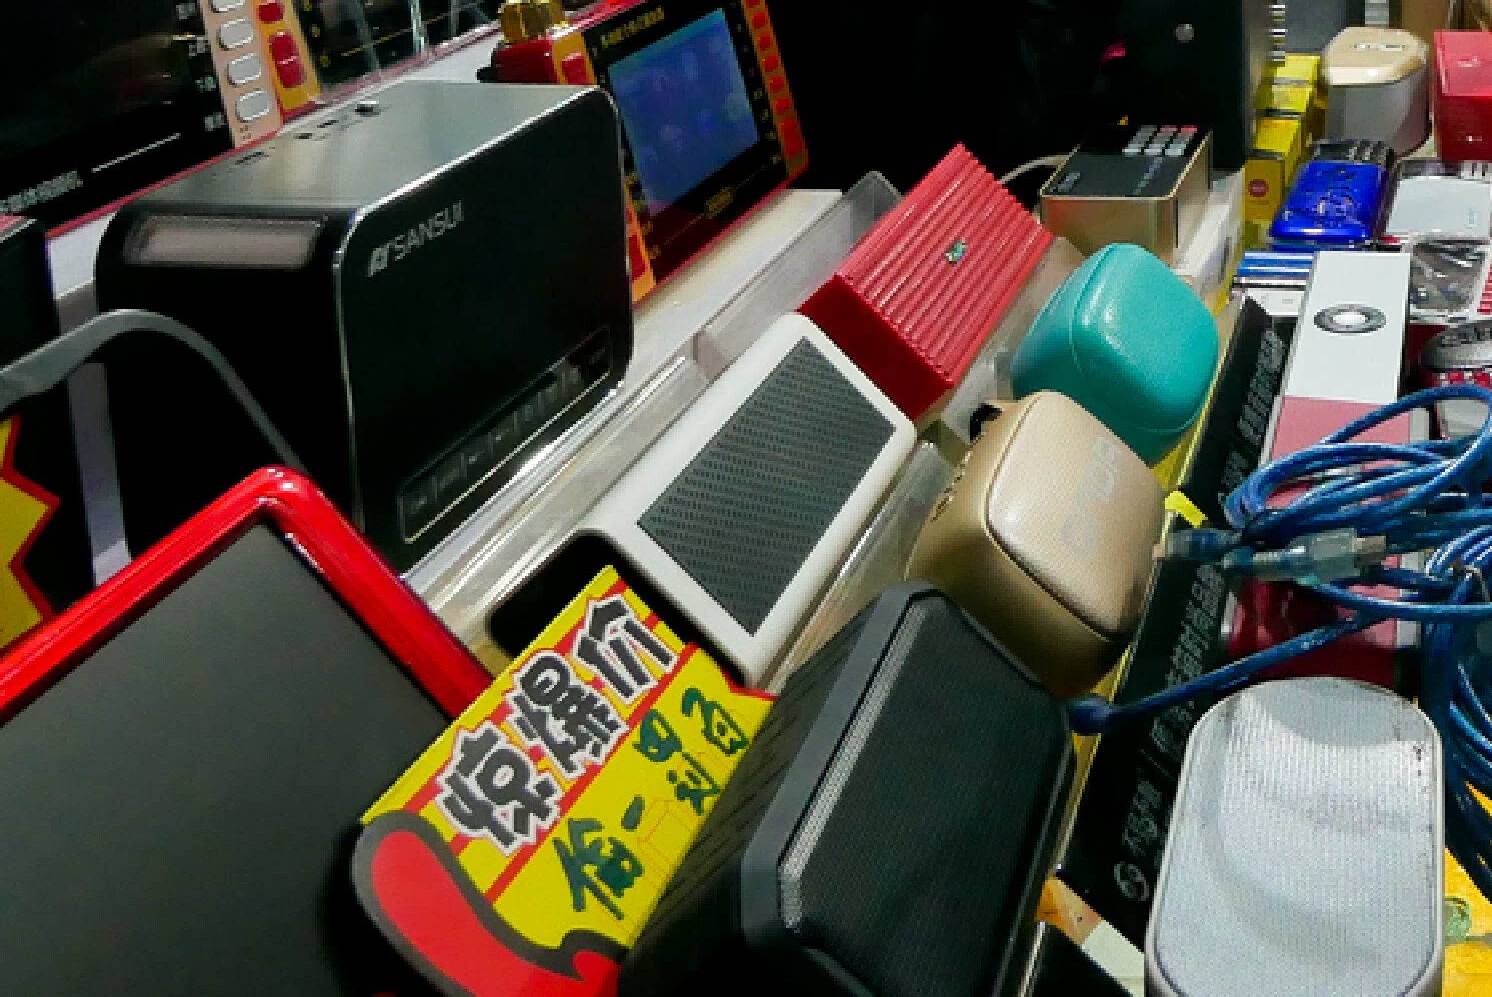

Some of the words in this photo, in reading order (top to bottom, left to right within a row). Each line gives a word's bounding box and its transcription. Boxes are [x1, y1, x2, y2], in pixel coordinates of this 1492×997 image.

[393, 202, 465, 269] SANSUI
[437, 595, 677, 855] 惊爆价
